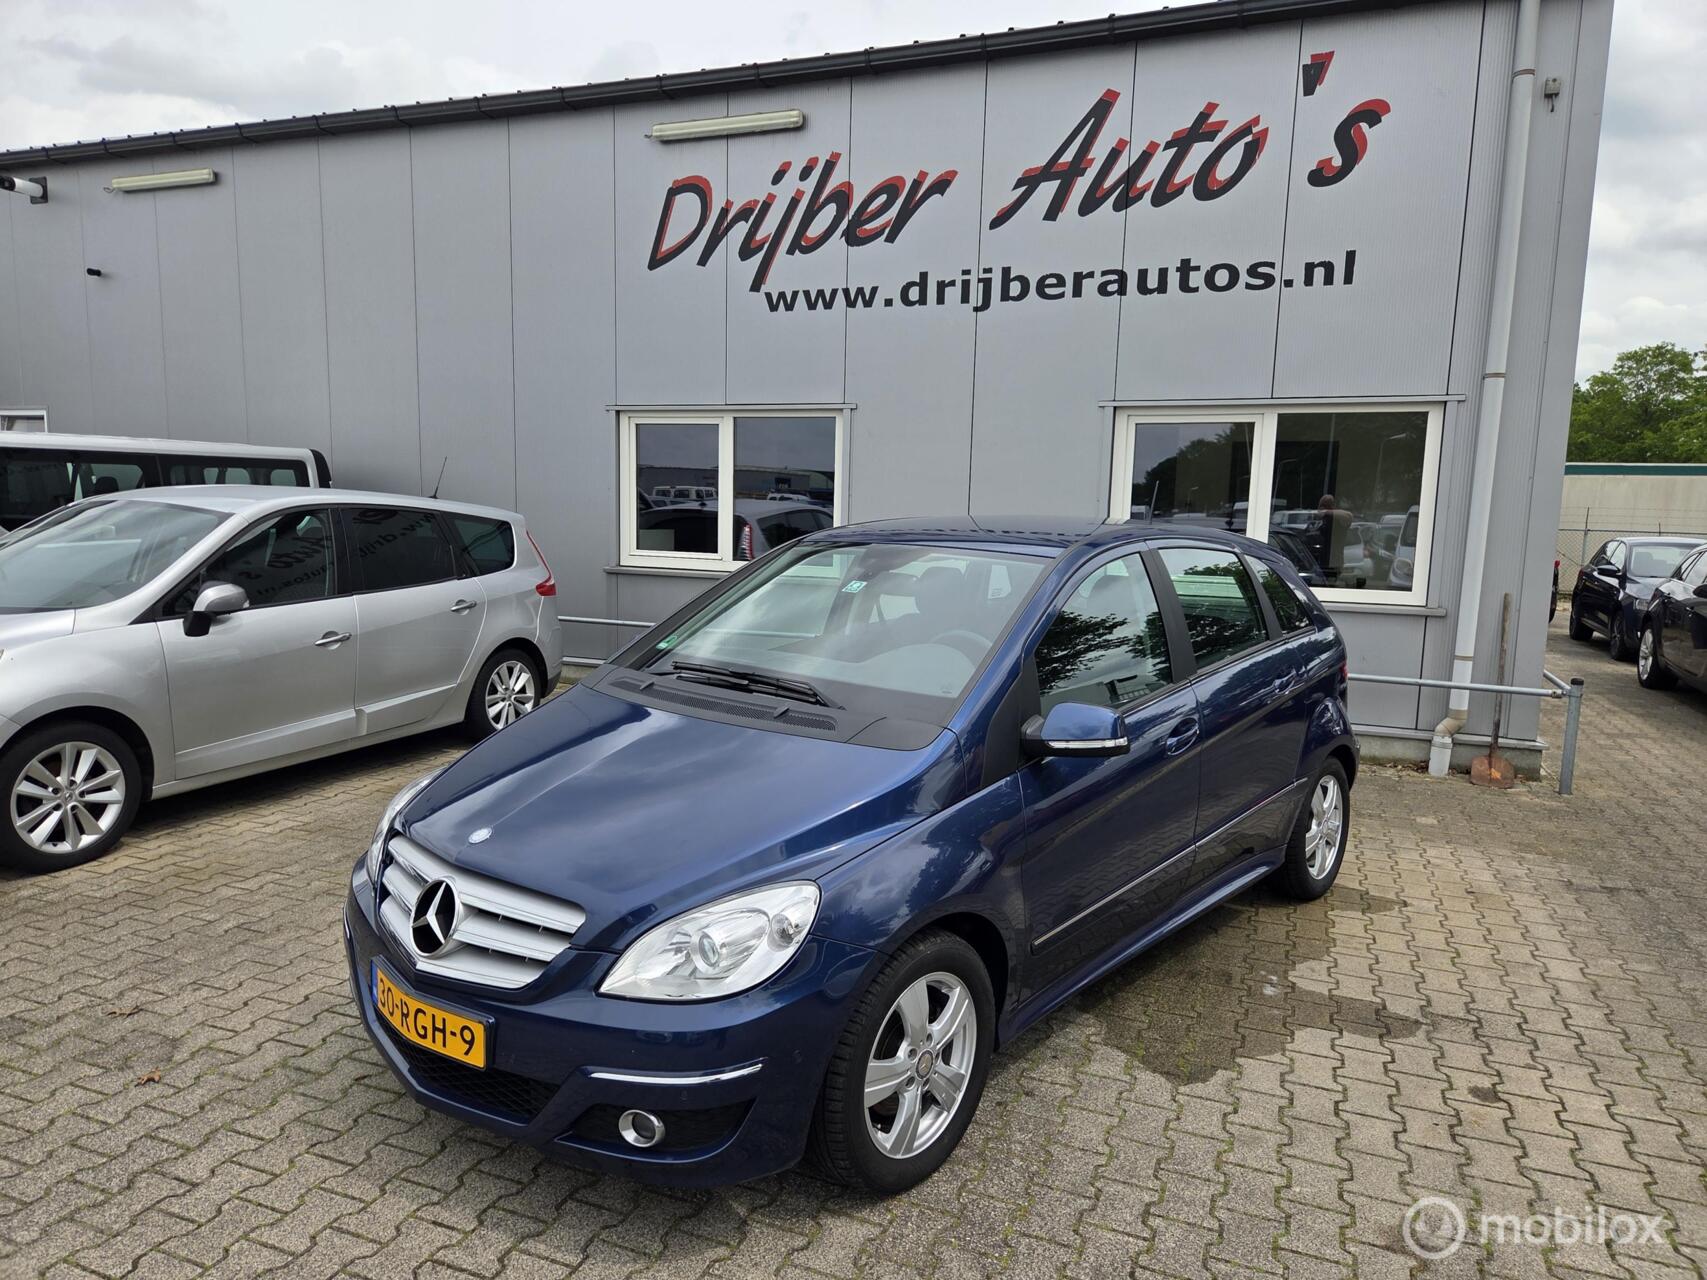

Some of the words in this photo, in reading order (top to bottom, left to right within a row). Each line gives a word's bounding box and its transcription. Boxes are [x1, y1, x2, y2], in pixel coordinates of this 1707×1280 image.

[647, 151, 958, 292] Drijber
[989, 50, 1391, 230] Auto's
[765, 250, 1356, 313] www.drijberautos.nl
[379, 977, 476, 1056] 30-RGH-9
